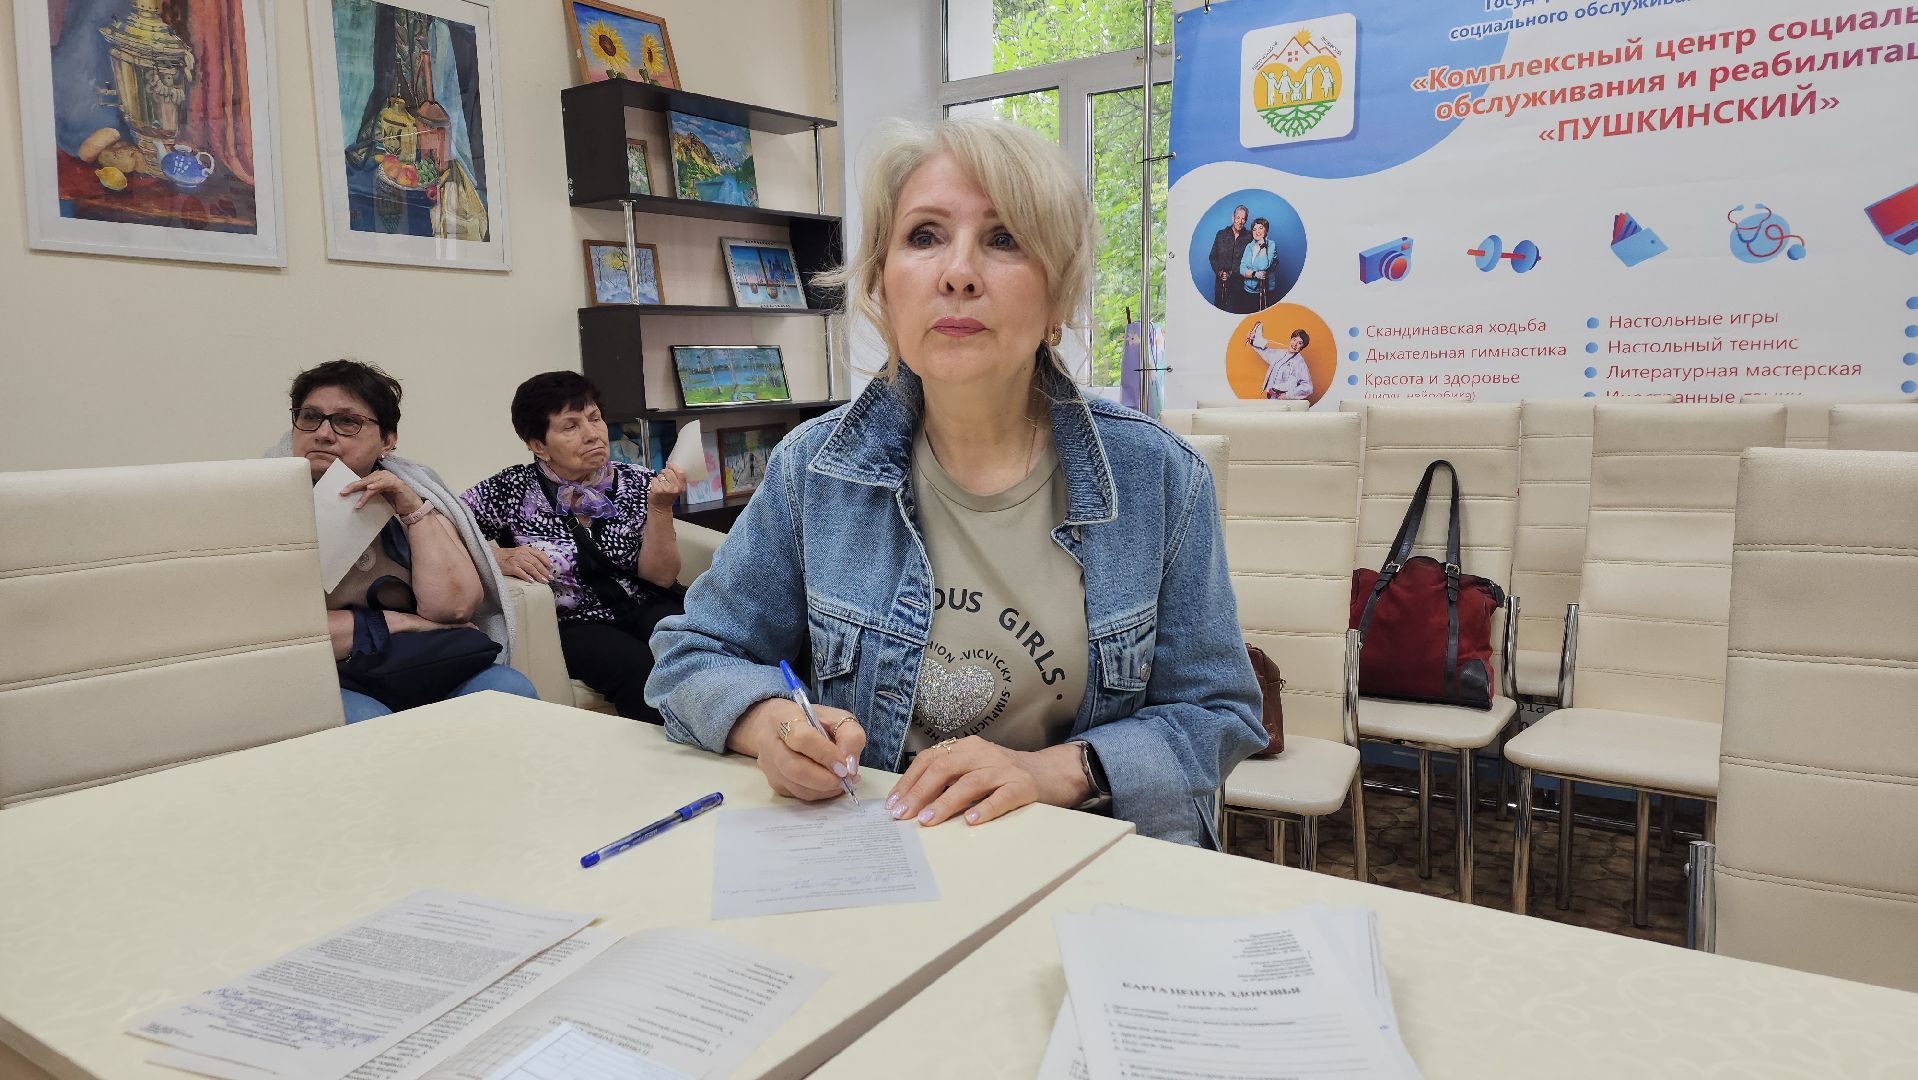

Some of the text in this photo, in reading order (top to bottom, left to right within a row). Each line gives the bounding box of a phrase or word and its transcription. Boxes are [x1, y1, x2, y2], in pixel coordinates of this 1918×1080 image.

[1451, 10, 1568, 40] социального
[1411, 6, 1918, 91] «Комплексный центр социаль
[1436, 75, 1665, 120] обслуживания
[1678, 70, 1697, 89] и
[1539, 83, 1841, 142] «ПУШКИНСКИЙ»
[1366, 318, 1547, 340] Скандинавская ходьба
[1609, 311, 1779, 329] Настольные игры
[1365, 345, 1567, 363] Дыхательная гимнастика
[1607, 336, 1799, 354] Настольный теннис
[1364, 373, 1521, 388] Красота и здоровье
[1606, 363, 1863, 382] Литературная мастерская
[998, 607, 1066, 686] GIRLS
